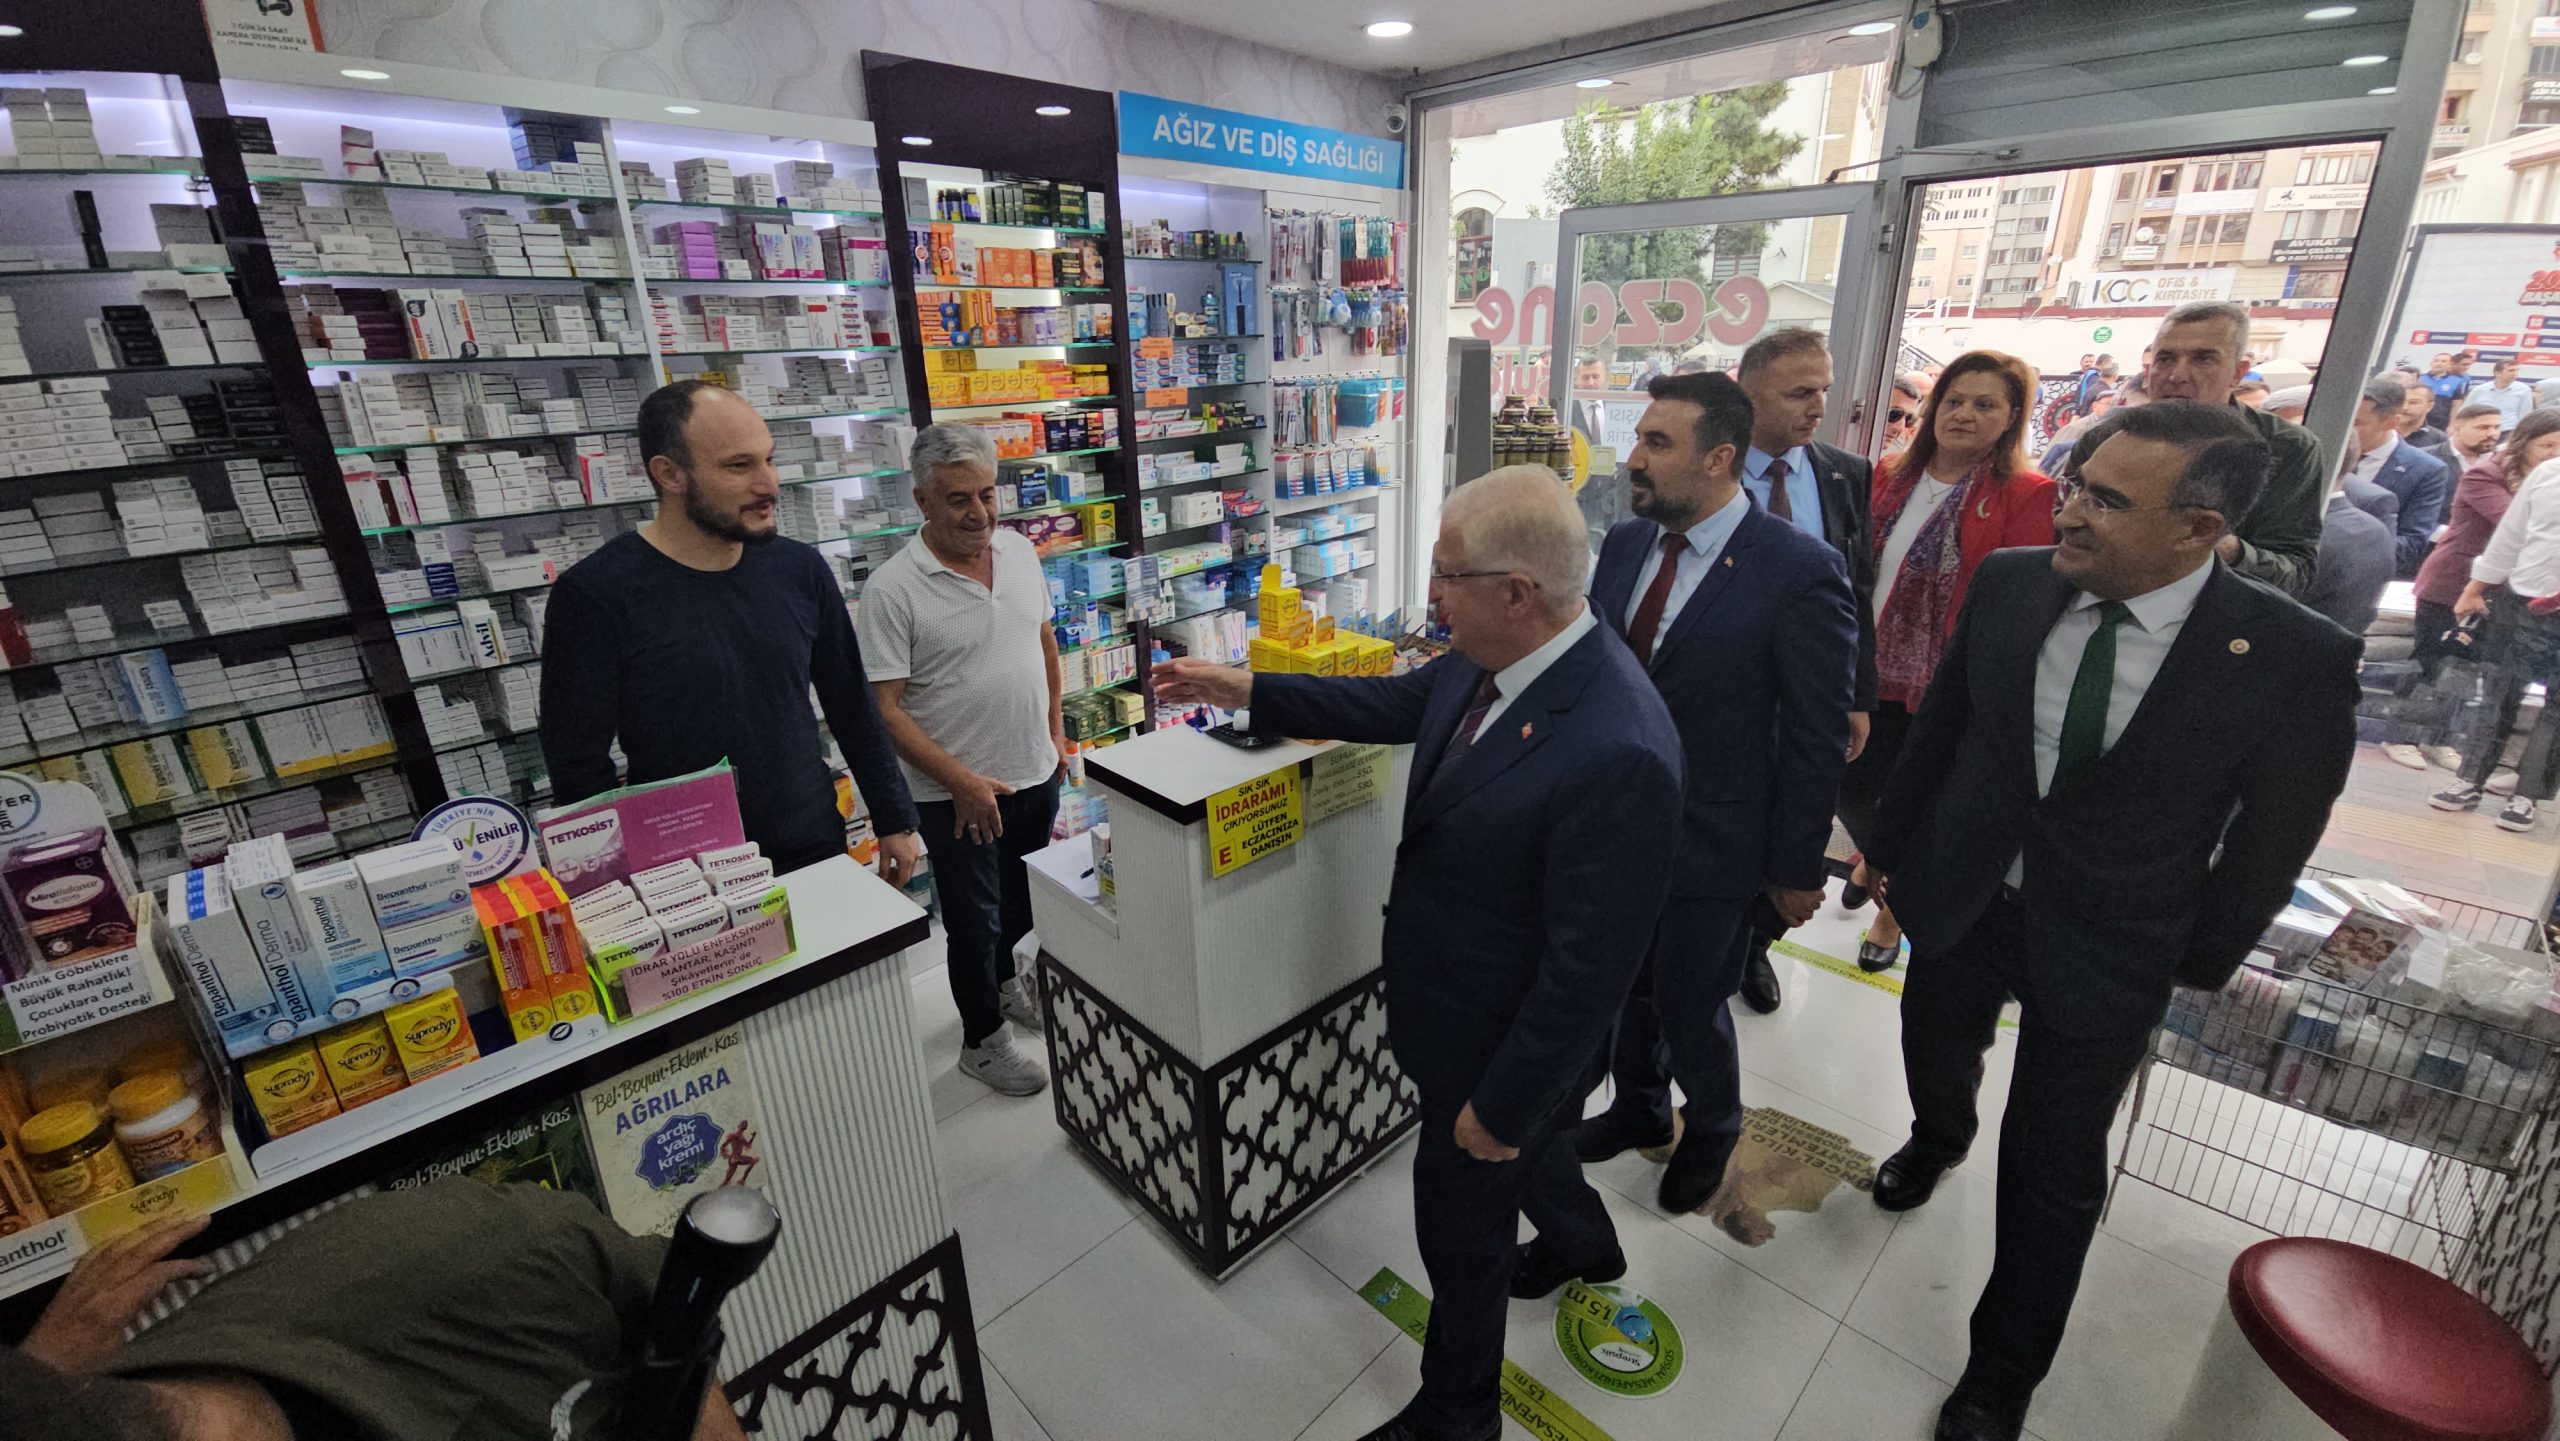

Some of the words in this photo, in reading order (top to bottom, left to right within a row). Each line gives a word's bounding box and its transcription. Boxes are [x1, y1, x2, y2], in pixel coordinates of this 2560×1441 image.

[1153, 111, 1217, 149] AĞIZ
[1222, 125, 1254, 155] VE
[1261, 129, 1297, 166] DİŞ
[1303, 140, 1384, 173] SAĞLIĞI
[2288, 239, 2342, 247] AVUKAT
[1239, 784, 1254, 797] SIK
[1255, 777, 1271, 790] SIK
[1216, 782, 1286, 822] İDRARAMI
[430, 807, 496, 833] TÜRKİYE'NİN
[1223, 797, 1289, 835] ÇIKIYORSUNUZ
[1252, 812, 1287, 833] LÜTFEN
[548, 817, 615, 846] TETKOSİST
[1241, 818, 1299, 849] ECZACINIZA
[1251, 832, 1292, 857] DANIŞIN
[709, 852, 756, 868] TETKOSİST
[1219, 846, 1232, 865] E
[376, 882, 427, 901] Bepanthol
[722, 869, 770, 888] TETKOSİST
[309, 886, 337, 944] Bepanthol
[672, 915, 725, 939] TETKOSİST
[178, 925, 203, 961] Derma
[256, 919, 284, 962] Derma
[393, 933, 443, 954] Bepanthol
[604, 938, 662, 964] TETKOSİST
[714, 937, 757, 959] KAŞINTI
[670, 948, 700, 966] YOLU
[10, 976, 52, 994] Minik
[54, 953, 129, 981] Göbeklere
[661, 985, 690, 1002] %100
[691, 972, 725, 991] ETKİN
[726, 956, 764, 978] SONUÇ
[19, 990, 64, 1009] Büyük
[67, 966, 131, 993] Rahatlık!
[192, 960, 229, 1018] Bepanthol
[269, 962, 307, 1023] epanthol
[22, 1011, 96, 1041] Probiyotik
[98, 992, 152, 1016] Desteği
[29, 994, 99, 1023] Çocuklara
[102, 983, 134, 999] Özel
[405, 1016, 457, 1043] Supradyn
[337, 1043, 386, 1068] Supradyn
[619, 1068, 666, 1101] Boyun
[668, 1047, 709, 1076] Eklem
[715, 1032, 738, 1050] Kas
[263, 1067, 316, 1096] Supradyn
[616, 1067, 731, 1136] AĞRILARA
[425, 1150, 482, 1183] Boyun
[484, 1125, 535, 1157] Eklem
[541, 1106, 571, 1132] Kas
[657, 1119, 697, 1145] ardıç
[663, 1131, 696, 1158] yağı
[1750, 1134, 1799, 1157] KİLO
[658, 1140, 704, 1171] kremi
[1565, 1286, 1588, 1305] m
[1587, 1300, 1612, 1321] 1,5
[1602, 1347, 1641, 1367] Strepsils
[1655, 1349, 1675, 1380] SOSYAL
[1513, 1372, 1529, 1386] m
[1527, 1381, 1546, 1401] 1,5
